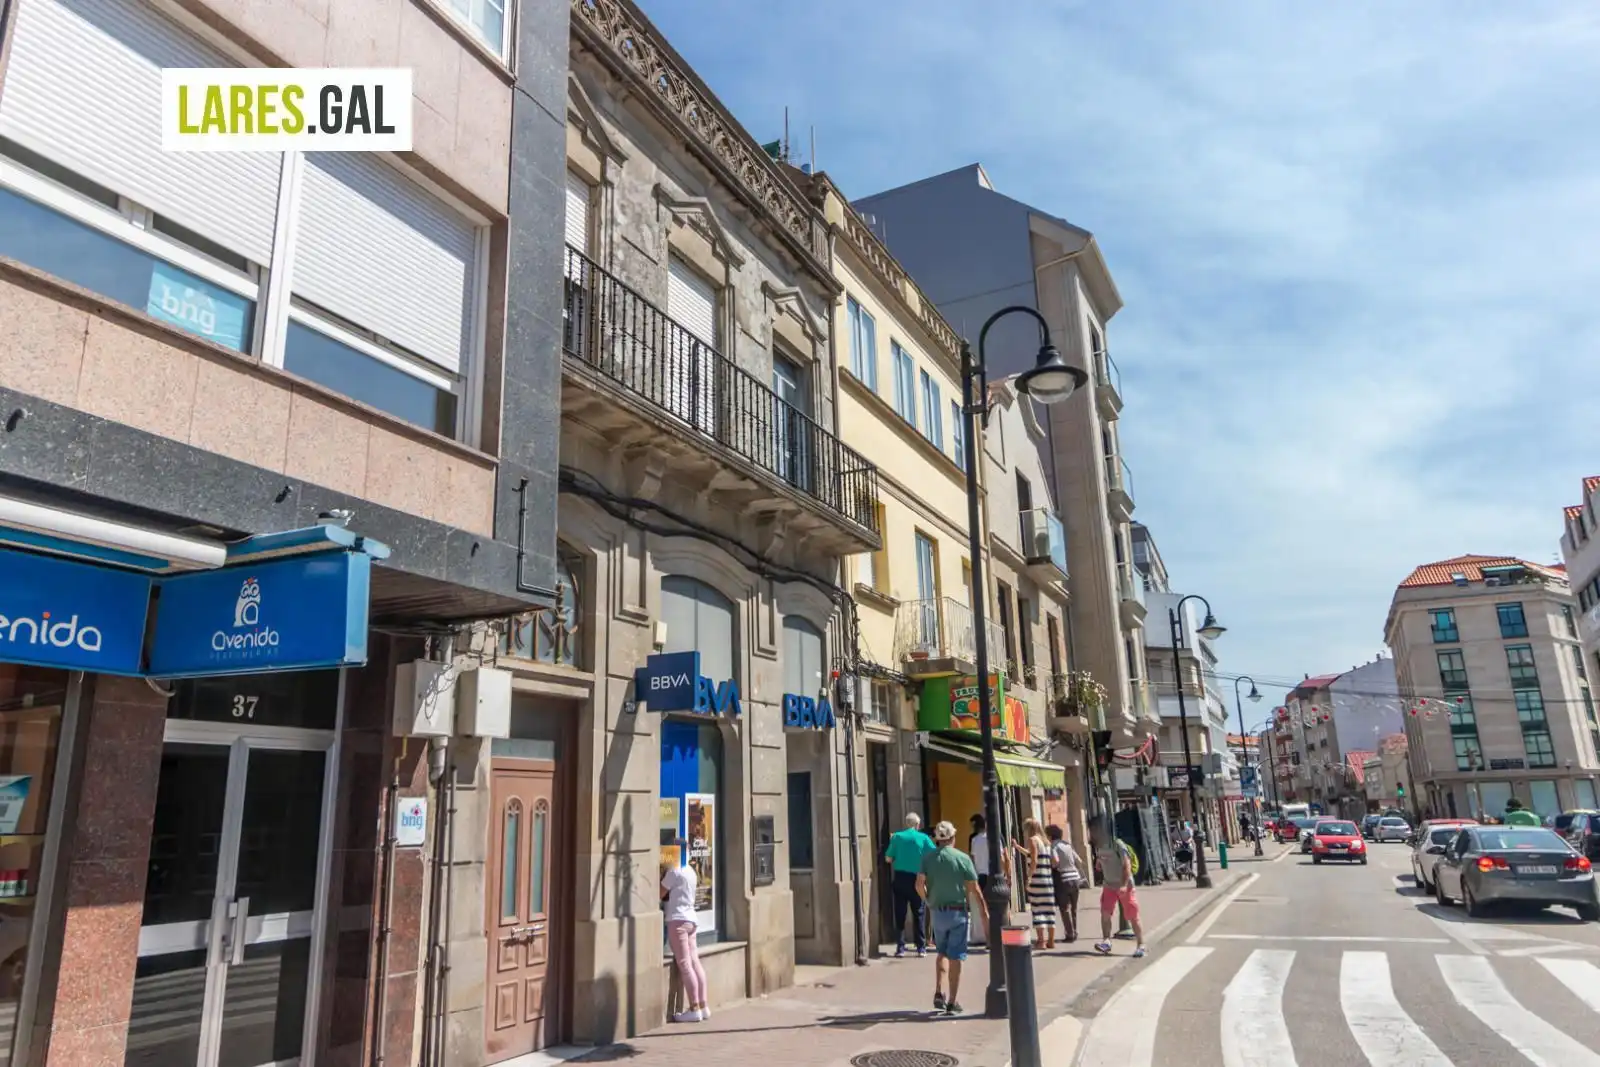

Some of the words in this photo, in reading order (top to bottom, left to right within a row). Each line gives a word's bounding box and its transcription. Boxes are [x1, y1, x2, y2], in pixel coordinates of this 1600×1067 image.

[161, 283, 216, 335] bng
[651, 672, 690, 690] BBVA
[698, 675, 742, 715] BVA
[232, 694, 260, 718] 37
[783, 692, 836, 729] BBVA
[401, 811, 424, 830] bng
